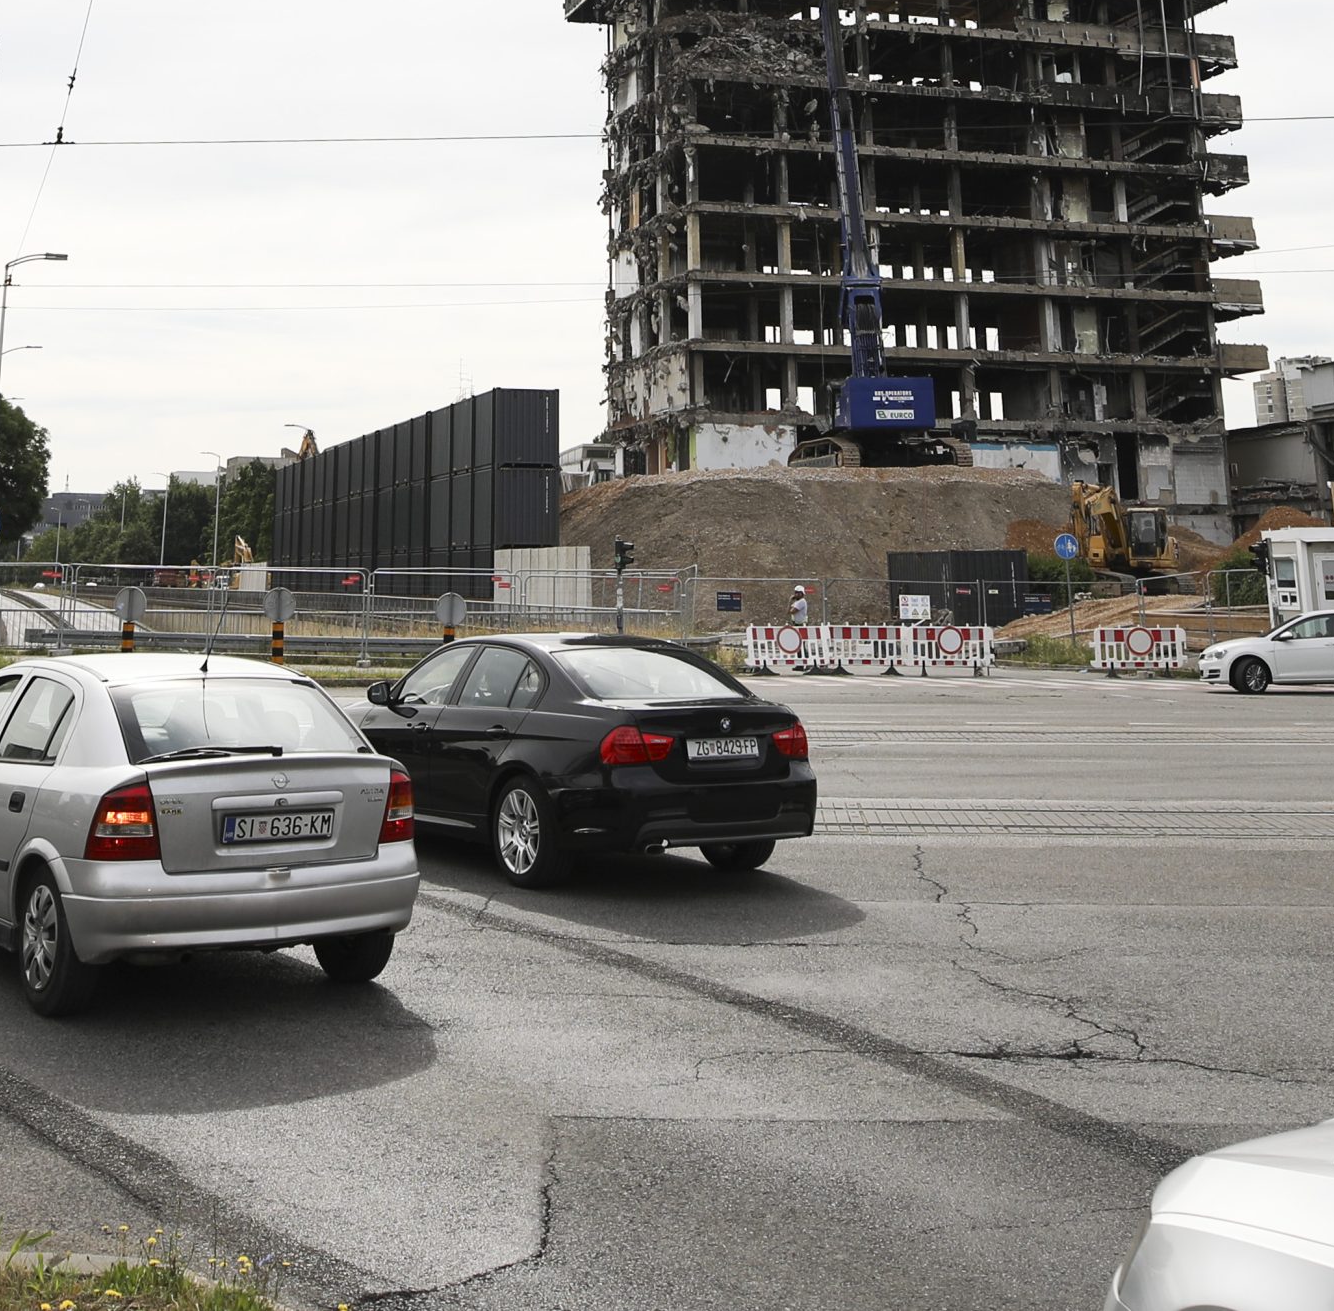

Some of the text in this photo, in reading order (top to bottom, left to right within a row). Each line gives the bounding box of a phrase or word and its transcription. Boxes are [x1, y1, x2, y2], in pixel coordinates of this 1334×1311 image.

[696, 739, 757, 756] ZG 8429-FP
[236, 814, 332, 839] SI 636-KM
